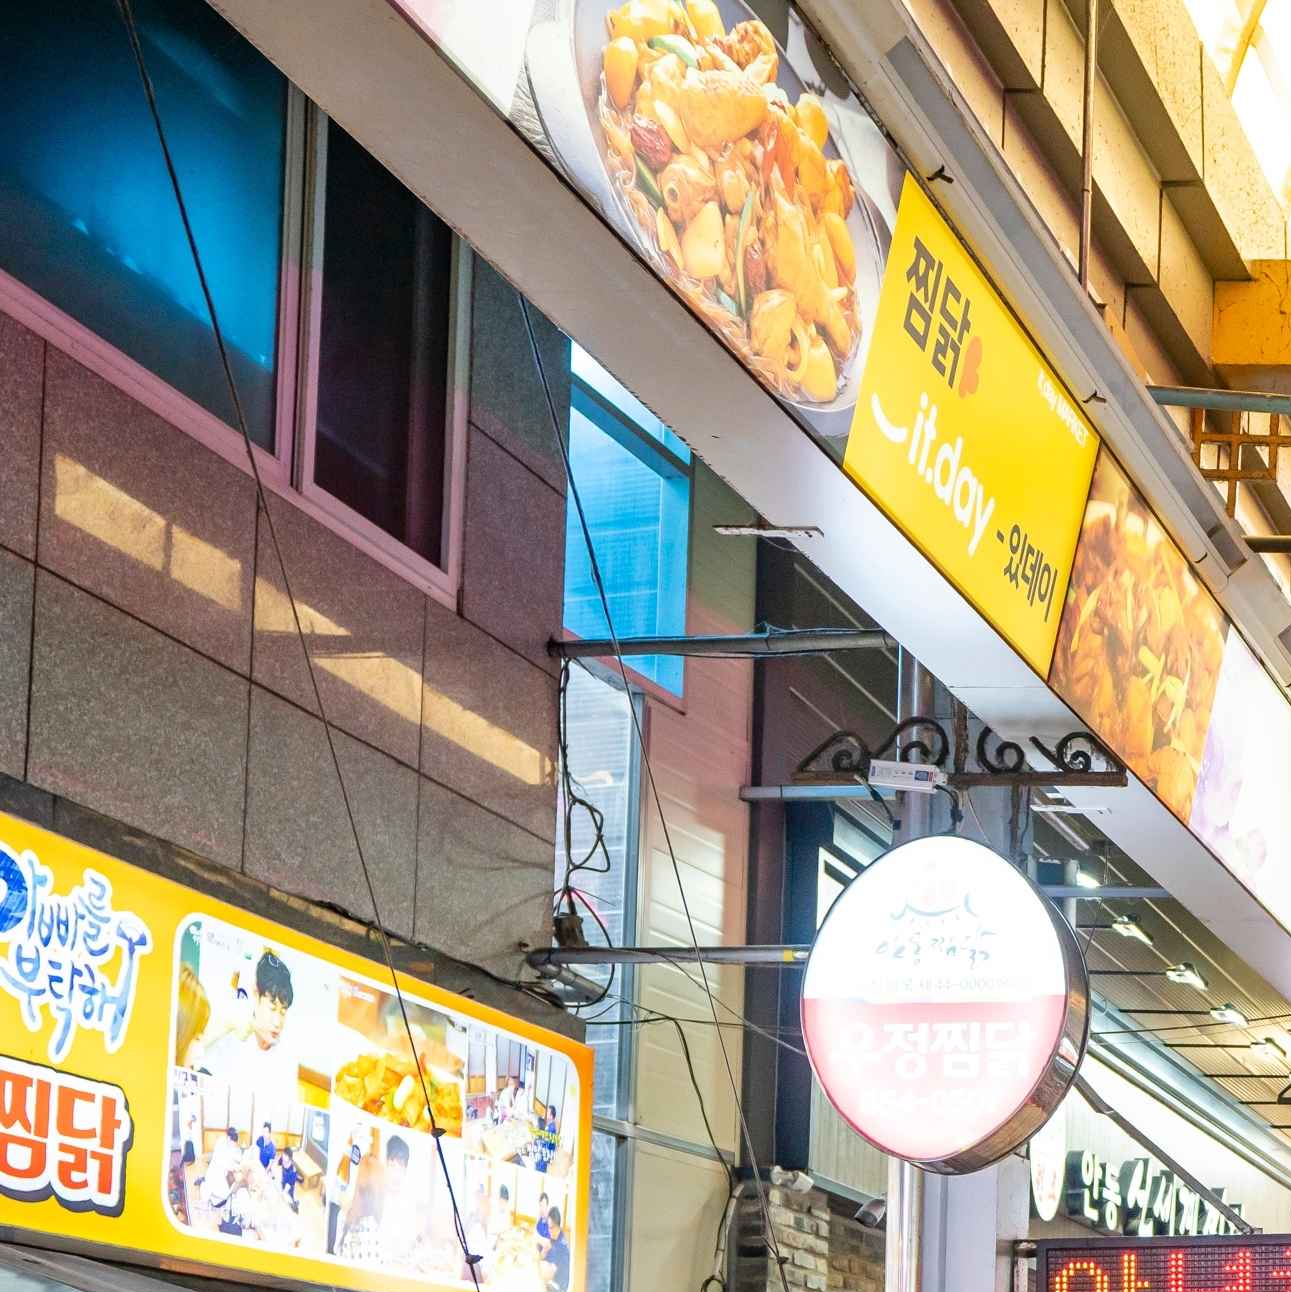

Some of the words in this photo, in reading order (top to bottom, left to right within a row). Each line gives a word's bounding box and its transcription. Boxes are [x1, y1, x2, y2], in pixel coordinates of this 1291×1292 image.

[904, 236, 972, 388] 찜닭
[907, 392, 995, 556] it.day
[0, 1069, 121, 1199] 찜닭
